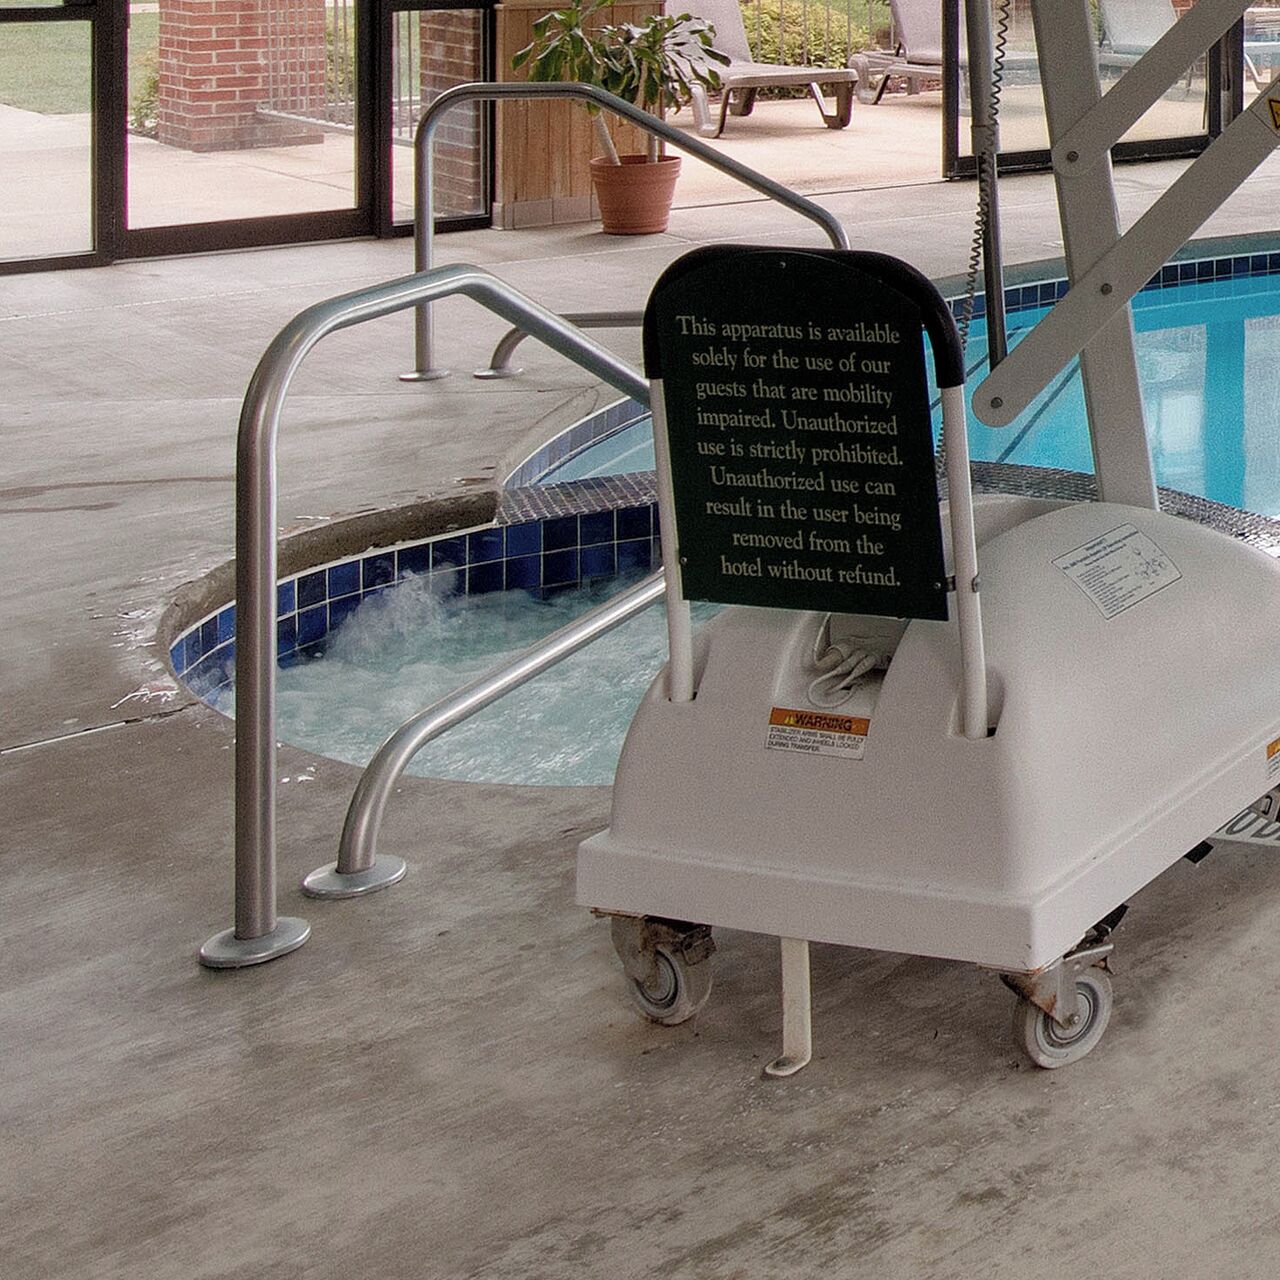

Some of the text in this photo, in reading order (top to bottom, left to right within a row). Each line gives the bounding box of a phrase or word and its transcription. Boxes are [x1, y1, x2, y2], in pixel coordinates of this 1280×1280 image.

[676, 316, 900, 344] This apparatus is available
[692, 346, 891, 374] solely for the use of our
[696, 378, 892, 408] guests that are mobility
[697, 407, 898, 435] impaired. Unauthorized
[697, 438, 903, 466] use is strictly prohibited.
[710, 466, 896, 496] Unauthorized use can
[706, 497, 902, 531] result in the user being
[732, 531, 884, 555] removed from the
[721, 556, 900, 586] hotel without refund.
[795, 713, 852, 731] WARNING
